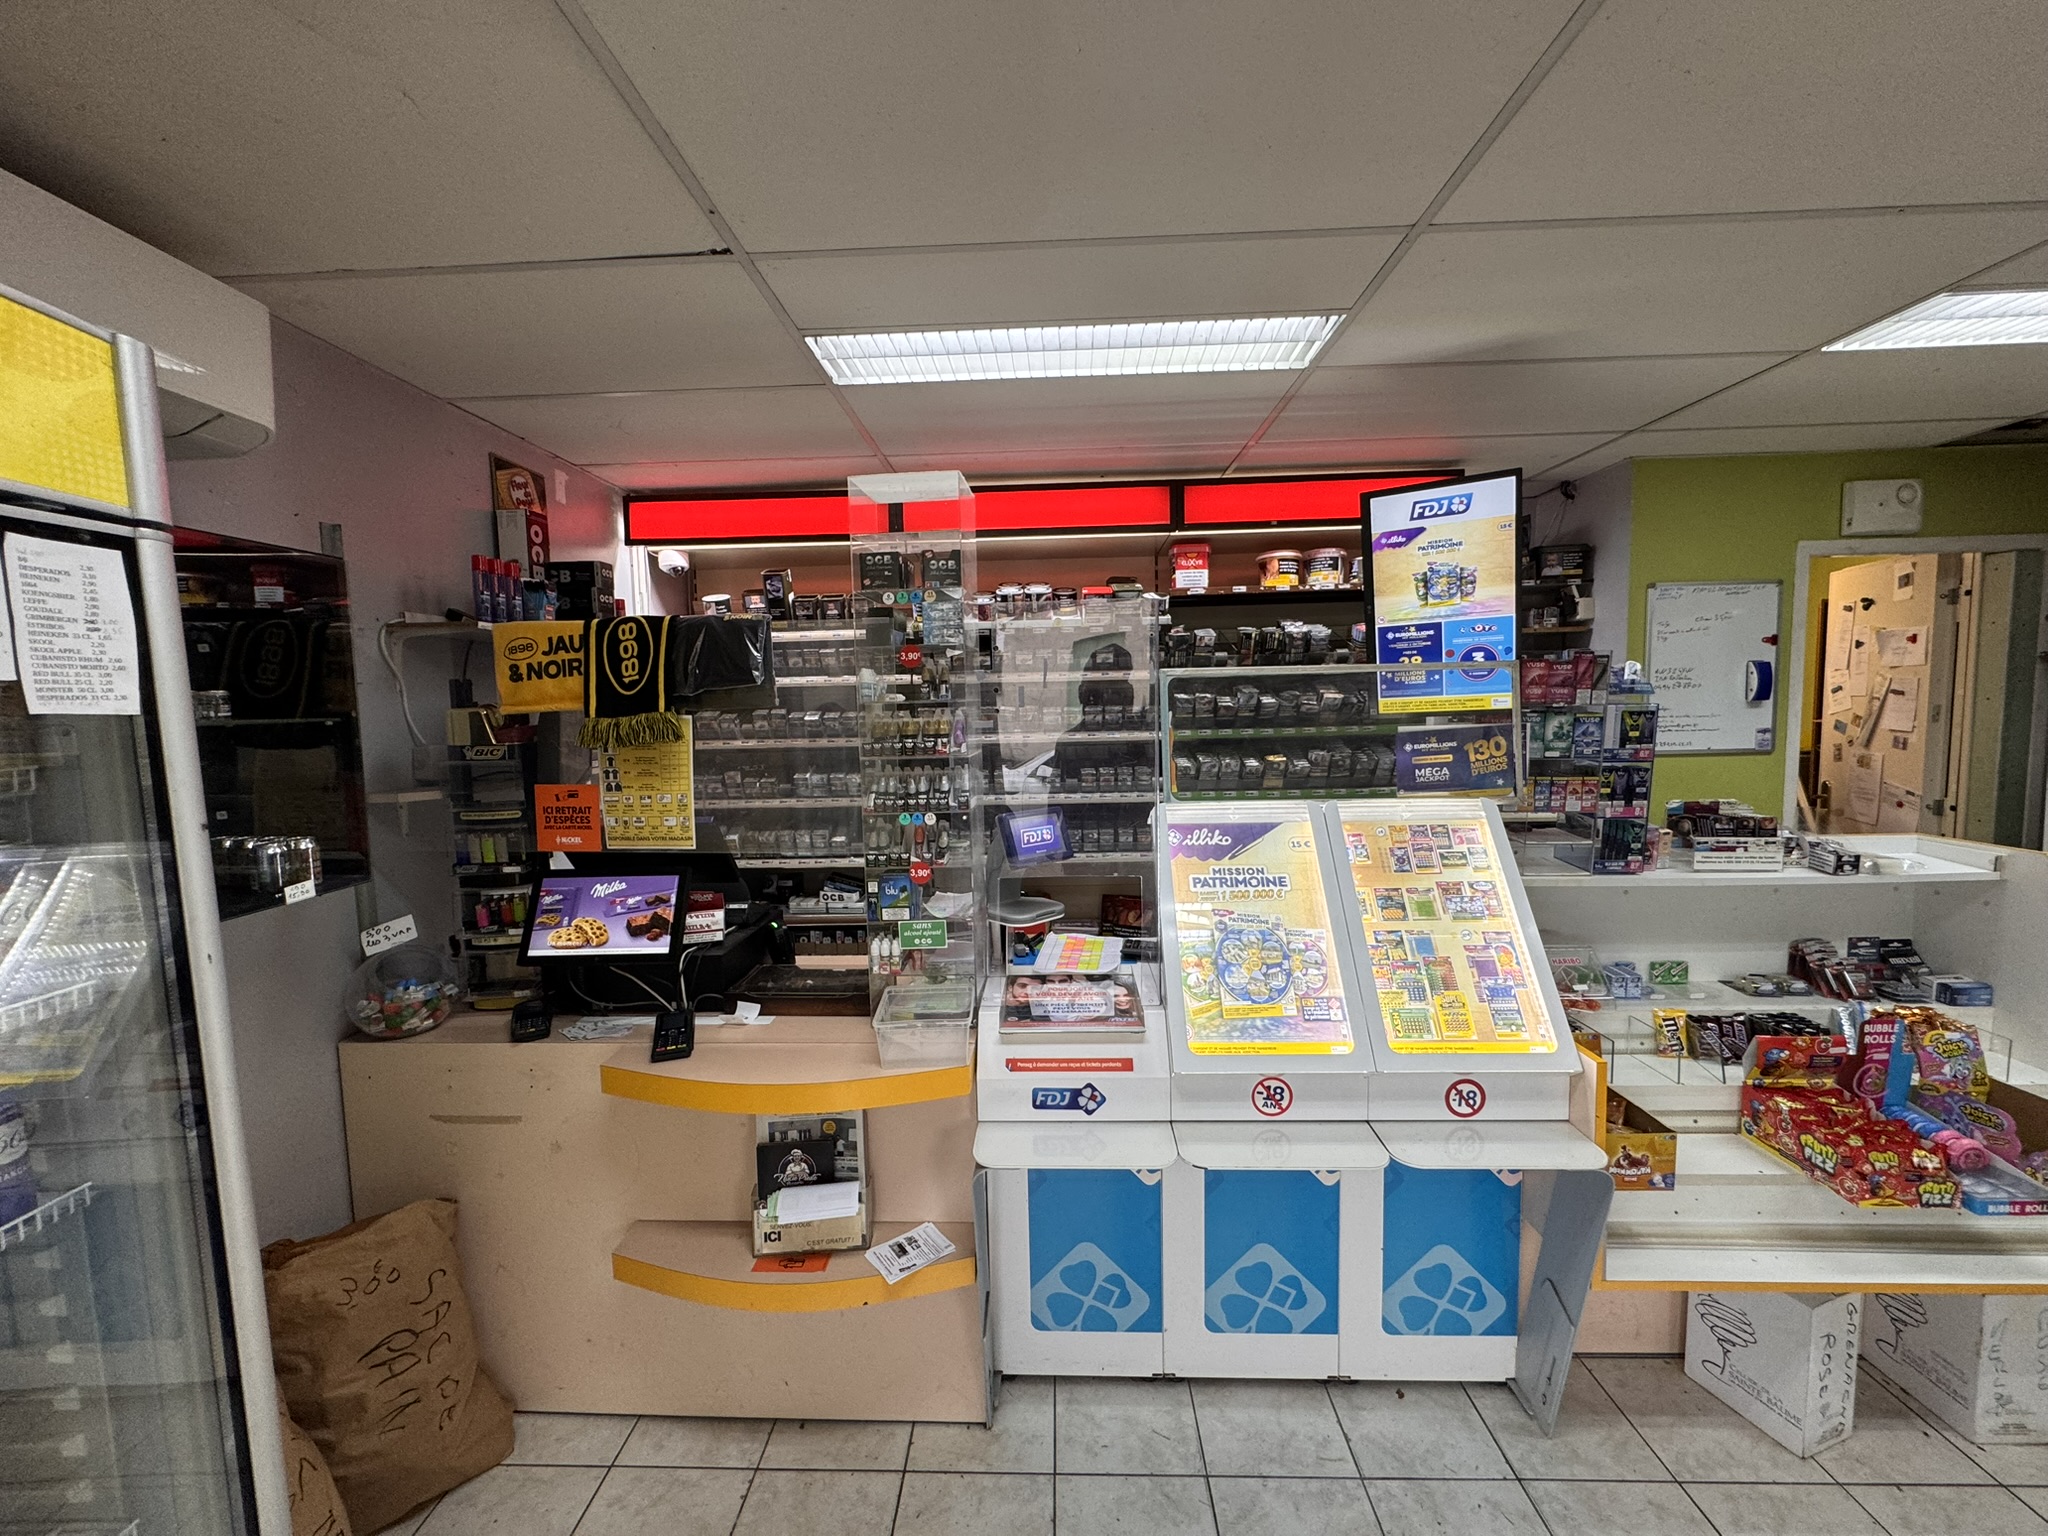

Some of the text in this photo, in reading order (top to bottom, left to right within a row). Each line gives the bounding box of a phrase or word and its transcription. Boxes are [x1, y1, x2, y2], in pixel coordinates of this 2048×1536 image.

[1413, 500, 1448, 518] FDJ
[1418, 541, 1463, 552] PATRIMOINE
[865, 556, 893, 565] OCB
[929, 560, 957, 570] OCB
[18, 564, 71, 577] DESPERADOS
[602, 568, 613, 578] OCB
[19, 572, 60, 583] HEINEKEN
[600, 594, 613, 603] OCB
[28, 630, 69, 638] HEINEKEN
[506, 641, 535, 656] 1898
[617, 621, 640, 684] 1898
[31, 662, 78, 670] CUBANISTO
[508, 664, 525, 683] &
[1394, 675, 1426, 683] D'EUROS
[1414, 741, 1457, 749] EUROMILLIONS
[1463, 736, 1507, 763] 130
[473, 748, 500, 757] BIC
[1471, 756, 1508, 769] MILLIONS
[1471, 763, 1508, 776] D'EUROS
[1415, 775, 1449, 783] JACKPOT
[543, 806, 592, 815] ICI RETRAIT
[545, 815, 591, 825] D'ESPÈCES
[1023, 830, 1042, 845] FDJ
[1182, 828, 1231, 846] illiko
[1212, 867, 1265, 876] MISSION
[1192, 876, 1288, 889] PATRIMOINE
[590, 880, 627, 898] Milka
[885, 884, 898, 895] blu
[1276, 889, 1284, 899] €
[822, 893, 845, 902] OCB
[1228, 917, 1270, 925] PATRIMOINE
[1552, 957, 1582, 965] HARIBO
[1888, 955, 1922, 965] maxell
[1864, 1024, 1899, 1033] BUBBLE
[1864, 1034, 1896, 1044] ROLLS
[1035, 1091, 1071, 1106] FDJ
[1256, 1085, 1285, 1101] -18
[1804, 1146, 1835, 1174] FIZZ
[1919, 1181, 1957, 1195] FRUTTI
[1921, 1193, 1954, 1206] FIZZ
[1988, 1201, 2021, 1212] BUBBLE
[764, 1230, 782, 1243] ICI
[826, 1237, 851, 1245] GRATUIT
[1728, 1370, 1802, 1427] SAINTE BAUME
